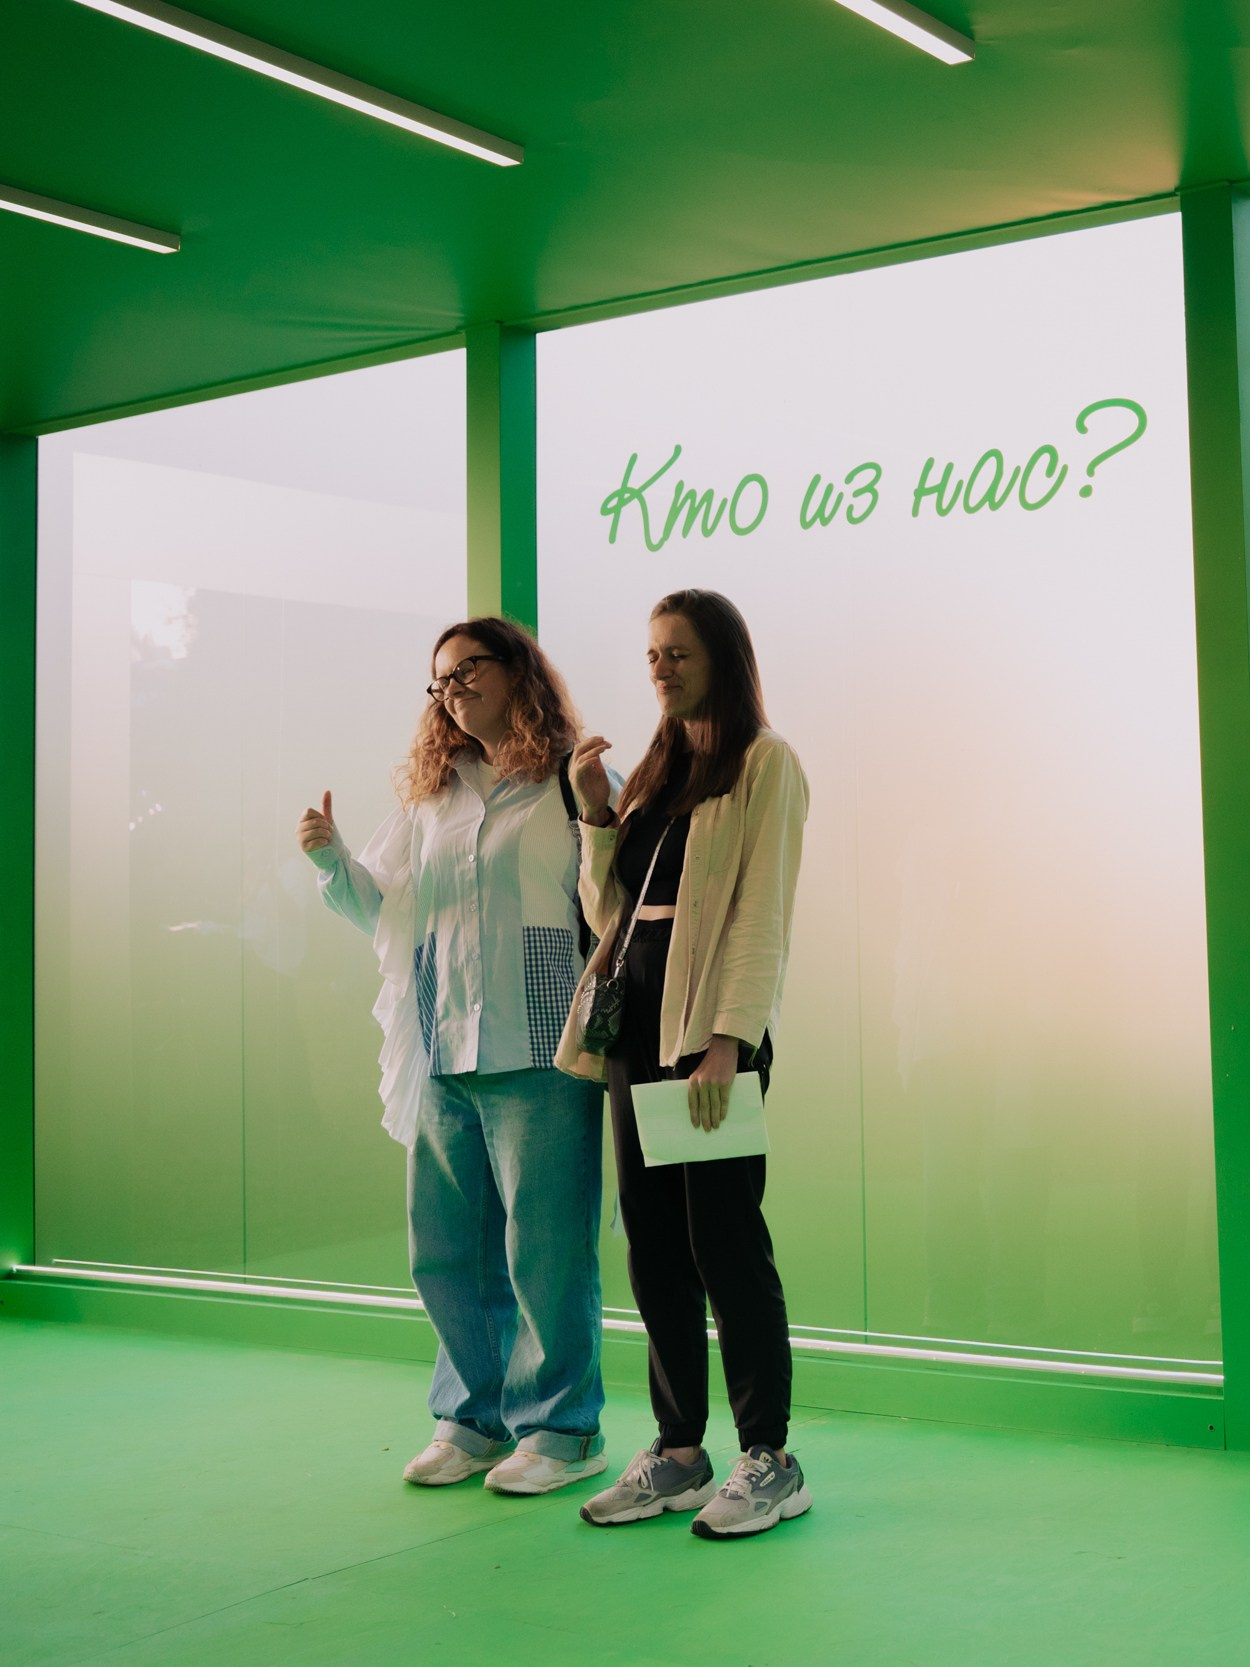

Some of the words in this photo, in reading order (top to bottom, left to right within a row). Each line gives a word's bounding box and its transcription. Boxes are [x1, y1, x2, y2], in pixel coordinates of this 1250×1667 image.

[600, 444, 768, 551] Кто
[800, 461, 882, 530] из
[912, 398, 1148, 517] нас?
